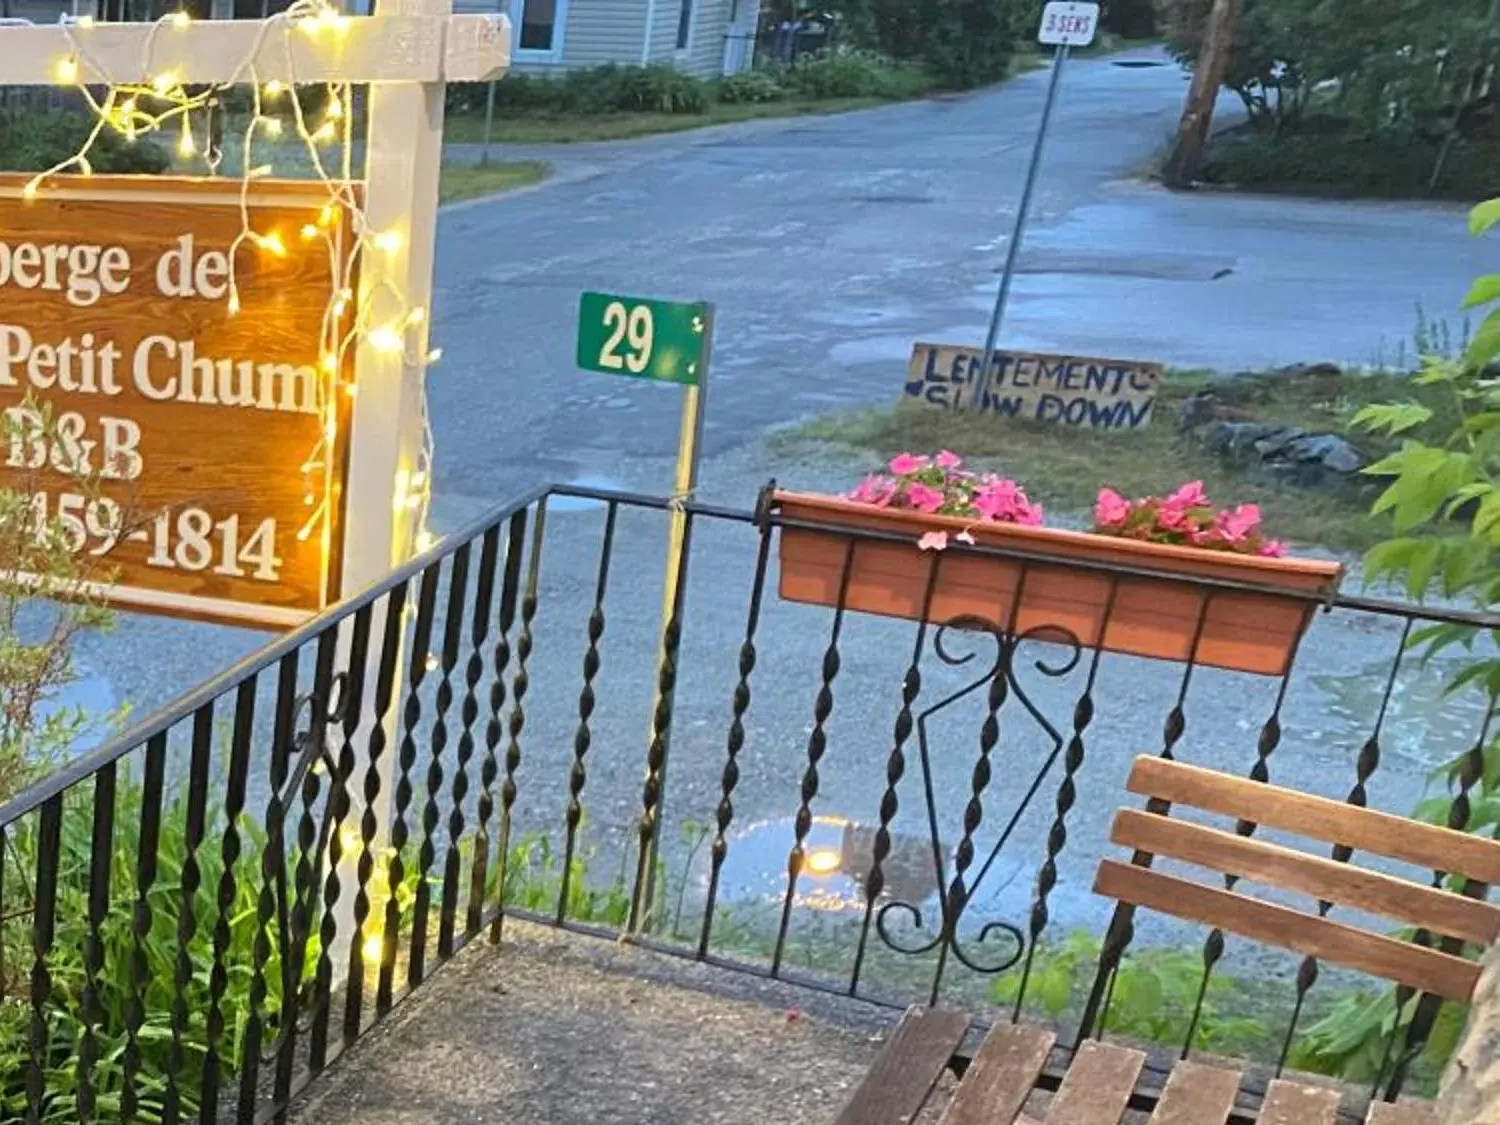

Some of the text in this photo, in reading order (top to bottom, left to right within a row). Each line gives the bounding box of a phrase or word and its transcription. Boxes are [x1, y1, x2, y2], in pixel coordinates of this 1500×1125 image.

[1046, 13, 1057, 32] 3
[155, 234, 232, 300] de
[598, 301, 654, 373] 29
[133, 335, 321, 414] Chum
[5, 406, 144, 481] B&B
[1035, 393, 1155, 428] DOWN
